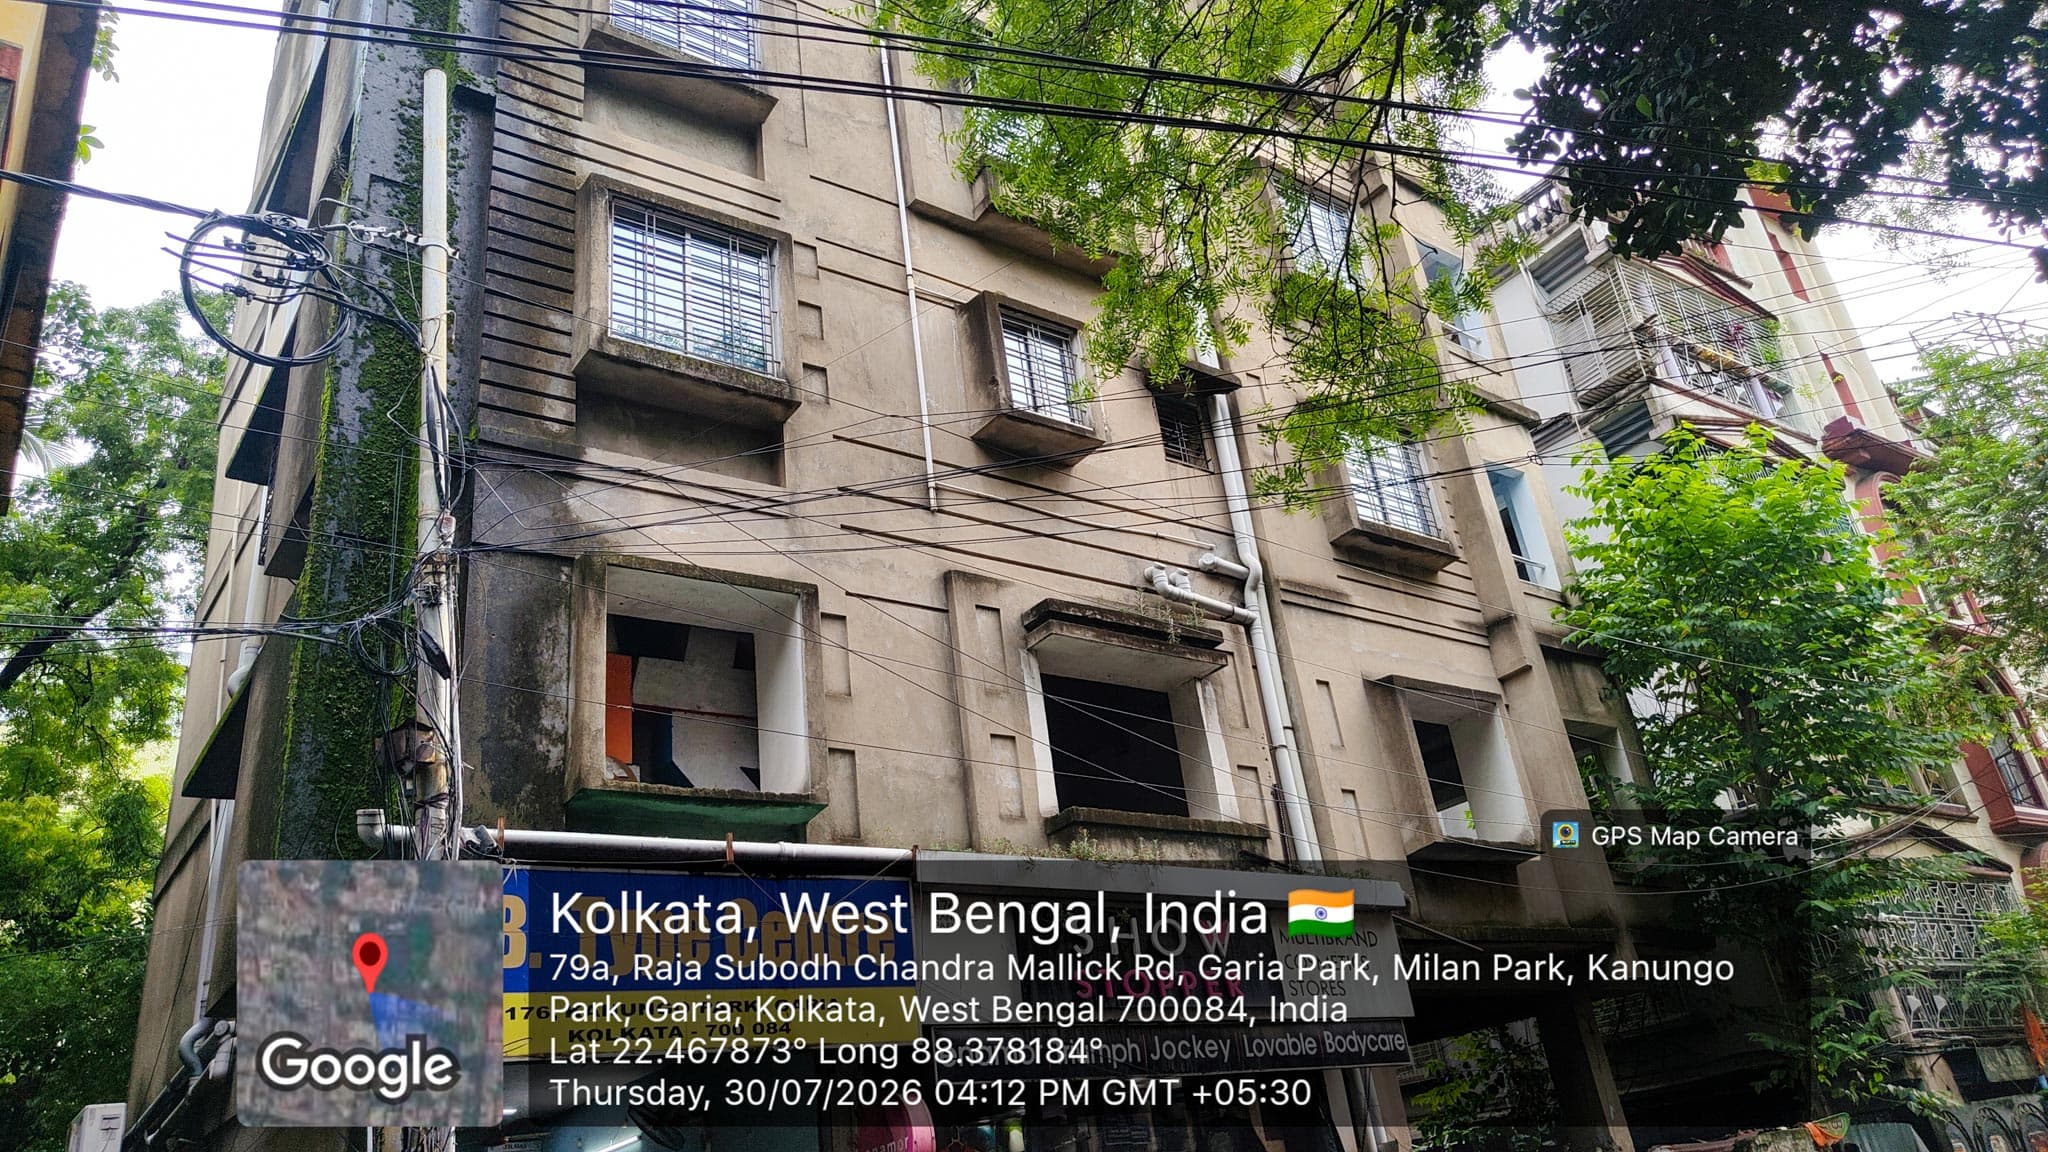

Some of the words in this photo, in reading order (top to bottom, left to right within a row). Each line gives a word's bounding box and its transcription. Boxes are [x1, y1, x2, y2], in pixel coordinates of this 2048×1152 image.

[725, 898, 895, 967] Centre
[1070, 915, 1231, 957] SHOW
[1074, 968, 1245, 999] STOPPER
[1289, 980, 1347, 997] STORES
[568, 1025, 684, 1042] KOLKATA
[705, 1023, 745, 1036] 700
[752, 1022, 792, 1035] 084
[1051, 1036, 1142, 1069] riumph
[1150, 1034, 1231, 1063] Jockey
[1243, 1033, 1318, 1058] Lovable
[1323, 1029, 1406, 1057] Bodycare
[865, 1136, 909, 1152] namor
